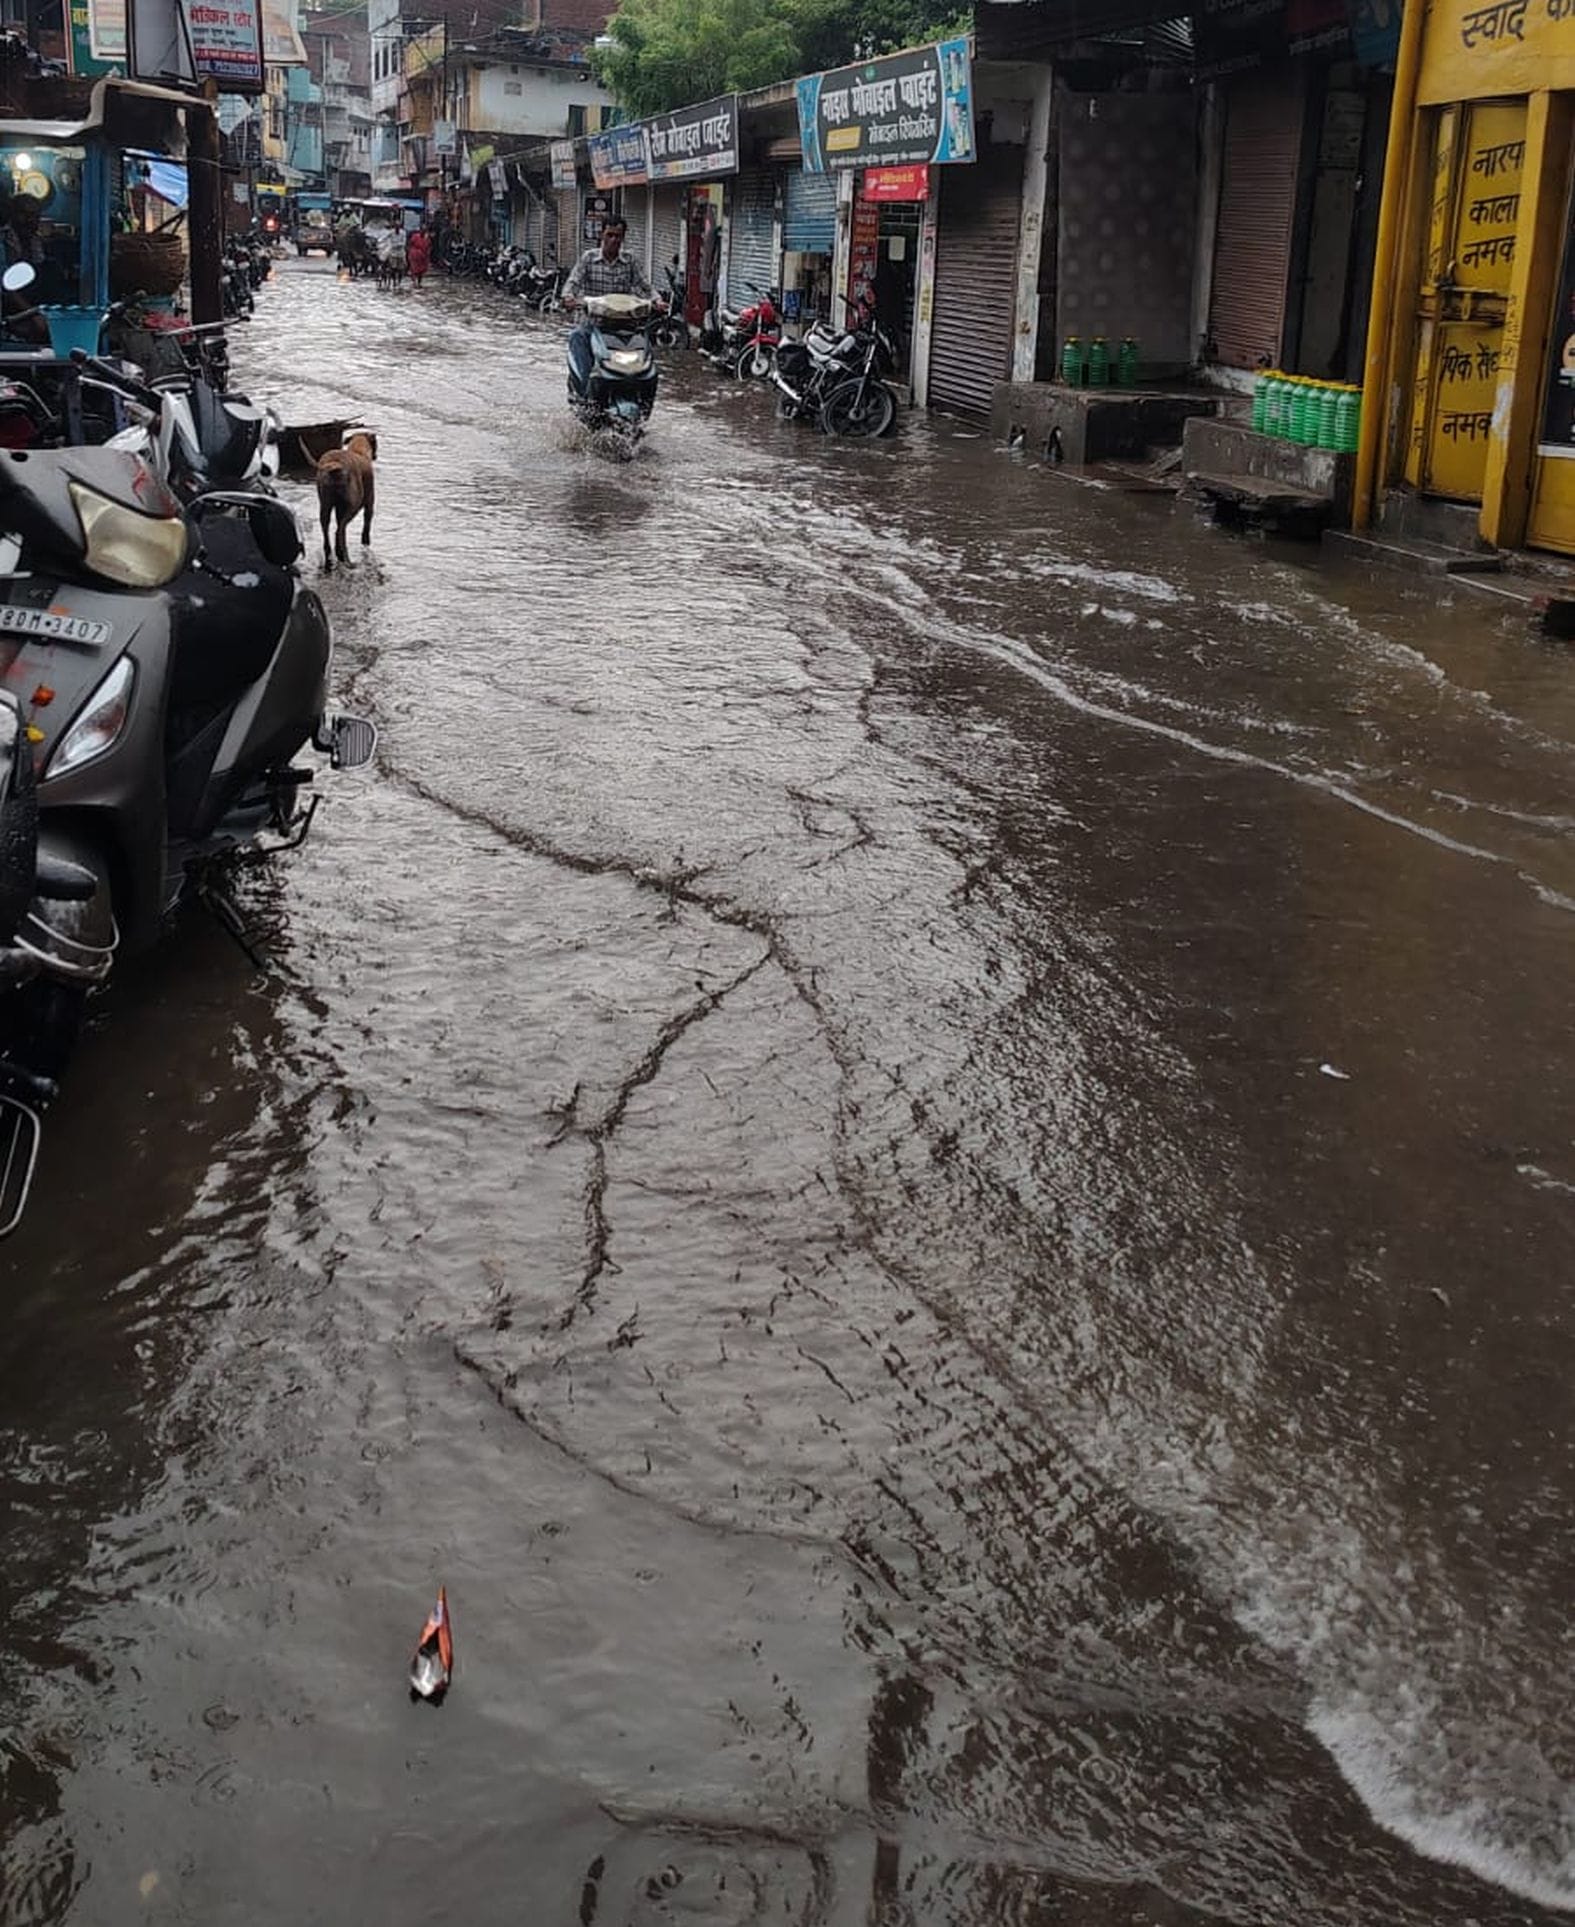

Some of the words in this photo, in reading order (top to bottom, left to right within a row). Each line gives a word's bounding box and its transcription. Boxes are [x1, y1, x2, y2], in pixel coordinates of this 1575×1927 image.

[1462, 0, 1529, 48] स्वाद
[851, 77, 897, 117] मोबाइल
[1469, 193, 1521, 225] काला
